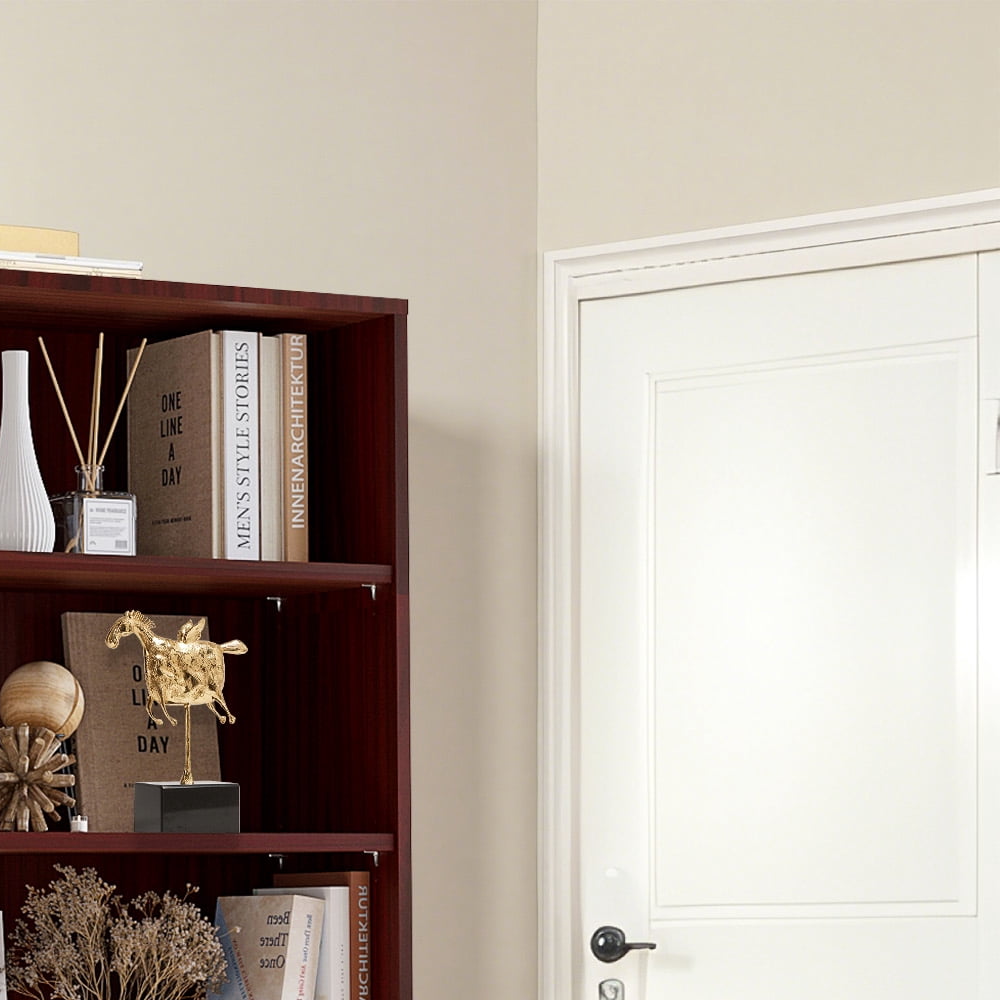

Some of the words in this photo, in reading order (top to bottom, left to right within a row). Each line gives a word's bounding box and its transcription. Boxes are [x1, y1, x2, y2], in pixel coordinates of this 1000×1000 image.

[235, 342, 249, 422] STORIES
[161, 391, 182, 413] ONE
[160, 416, 183, 438] LINE
[290, 334, 305, 529] INNENARCHITEKTUR
[168, 443, 176, 461] A
[236, 427, 249, 487] STYLE
[161, 466, 182, 487] DAY
[236, 492, 250, 550] MEN'S
[137, 735, 169, 754] DAY
